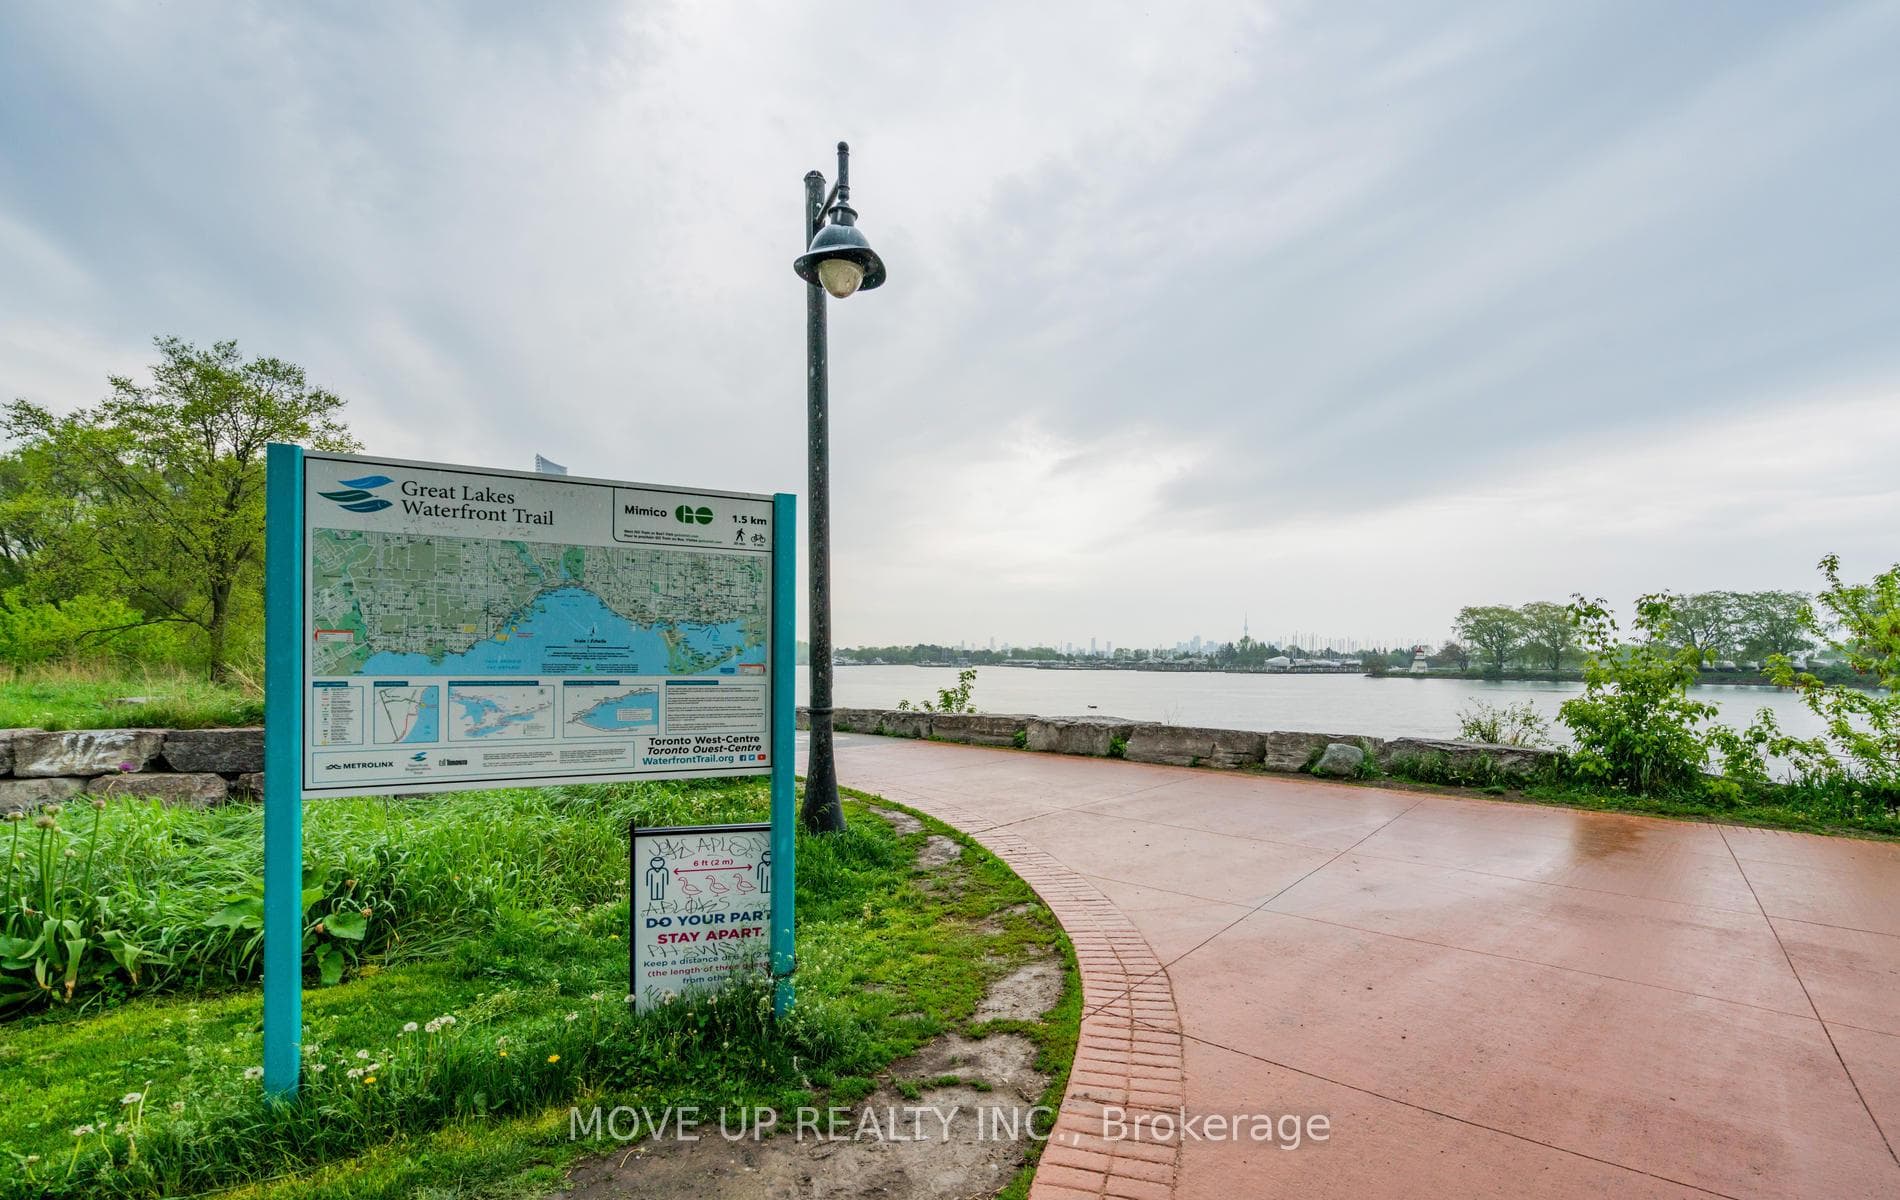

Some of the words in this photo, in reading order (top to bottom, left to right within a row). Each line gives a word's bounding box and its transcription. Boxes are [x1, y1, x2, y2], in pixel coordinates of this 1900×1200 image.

[401, 480, 457, 500] Great
[462, 486, 515, 504] Lakes
[401, 500, 507, 522] Waterfront
[512, 508, 554, 526] Trail
[624, 504, 668, 518] Mimico
[732, 514, 748, 524] 1.5
[750, 516, 767, 526] km
[648, 737, 692, 746] Toronto
[695, 735, 760, 744] West-Centre
[647, 746, 689, 755] Toronto
[692, 744, 761, 754] Ouest-Centre
[343, 761, 394, 769] METROLINX
[642, 754, 735, 766] WaterfrontTrail.org
[646, 917, 672, 928] DO
[677, 913, 726, 926] YOUR
[657, 932, 701, 944] STAY
[706, 927, 765, 941] APART.
[643, 960, 668, 968] Keep
[679, 955, 719, 965] distance
[648, 970, 667, 978] (the
[670, 967, 701, 976] length
[703, 965, 714, 973] of
[682, 976, 705, 984] from
